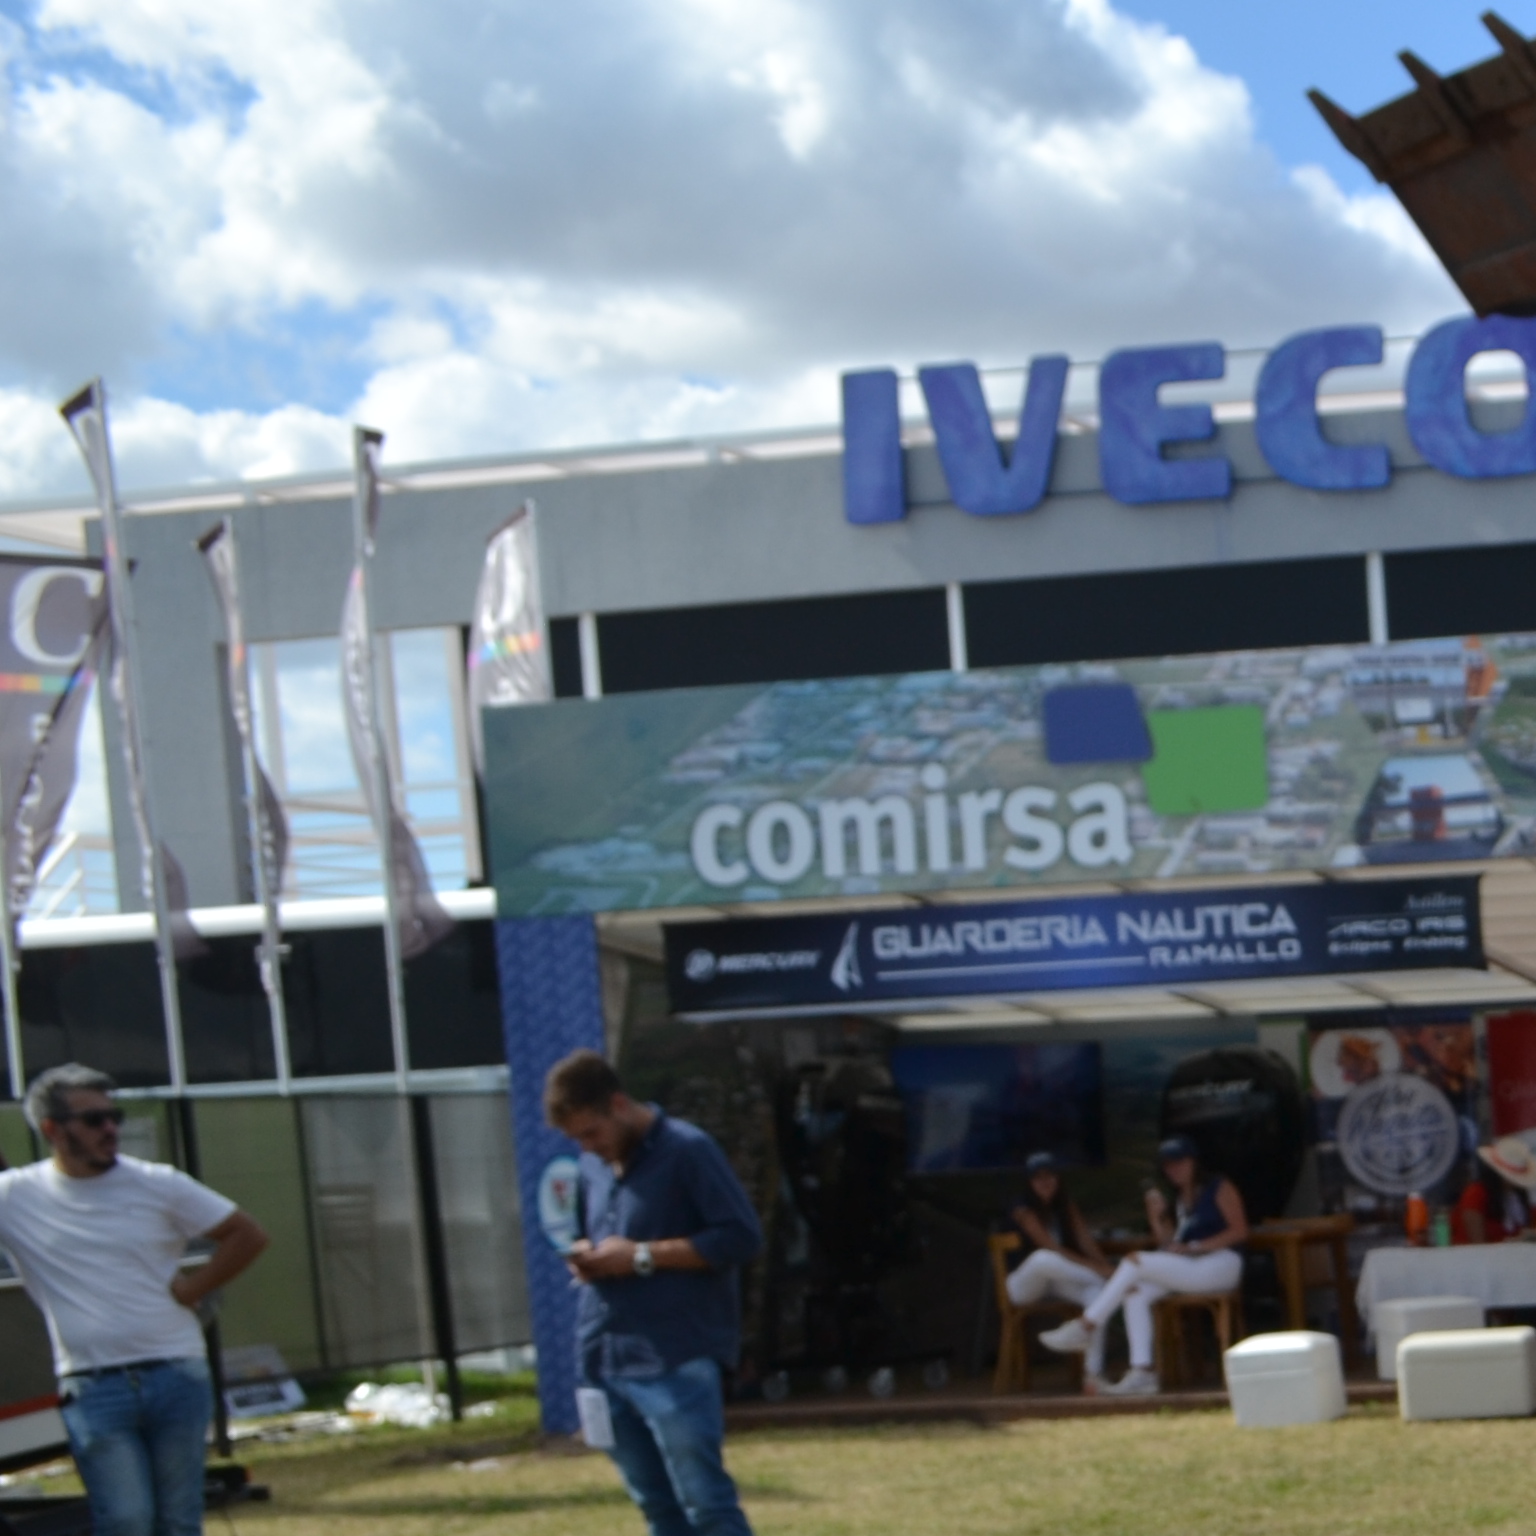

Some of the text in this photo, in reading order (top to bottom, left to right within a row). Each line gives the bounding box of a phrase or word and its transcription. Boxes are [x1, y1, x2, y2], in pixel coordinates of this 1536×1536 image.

[691, 765, 1132, 888] comirsa
[872, 902, 1298, 960] GUARDERIA NAUTICA
[1149, 937, 1300, 968] RAMALLO
